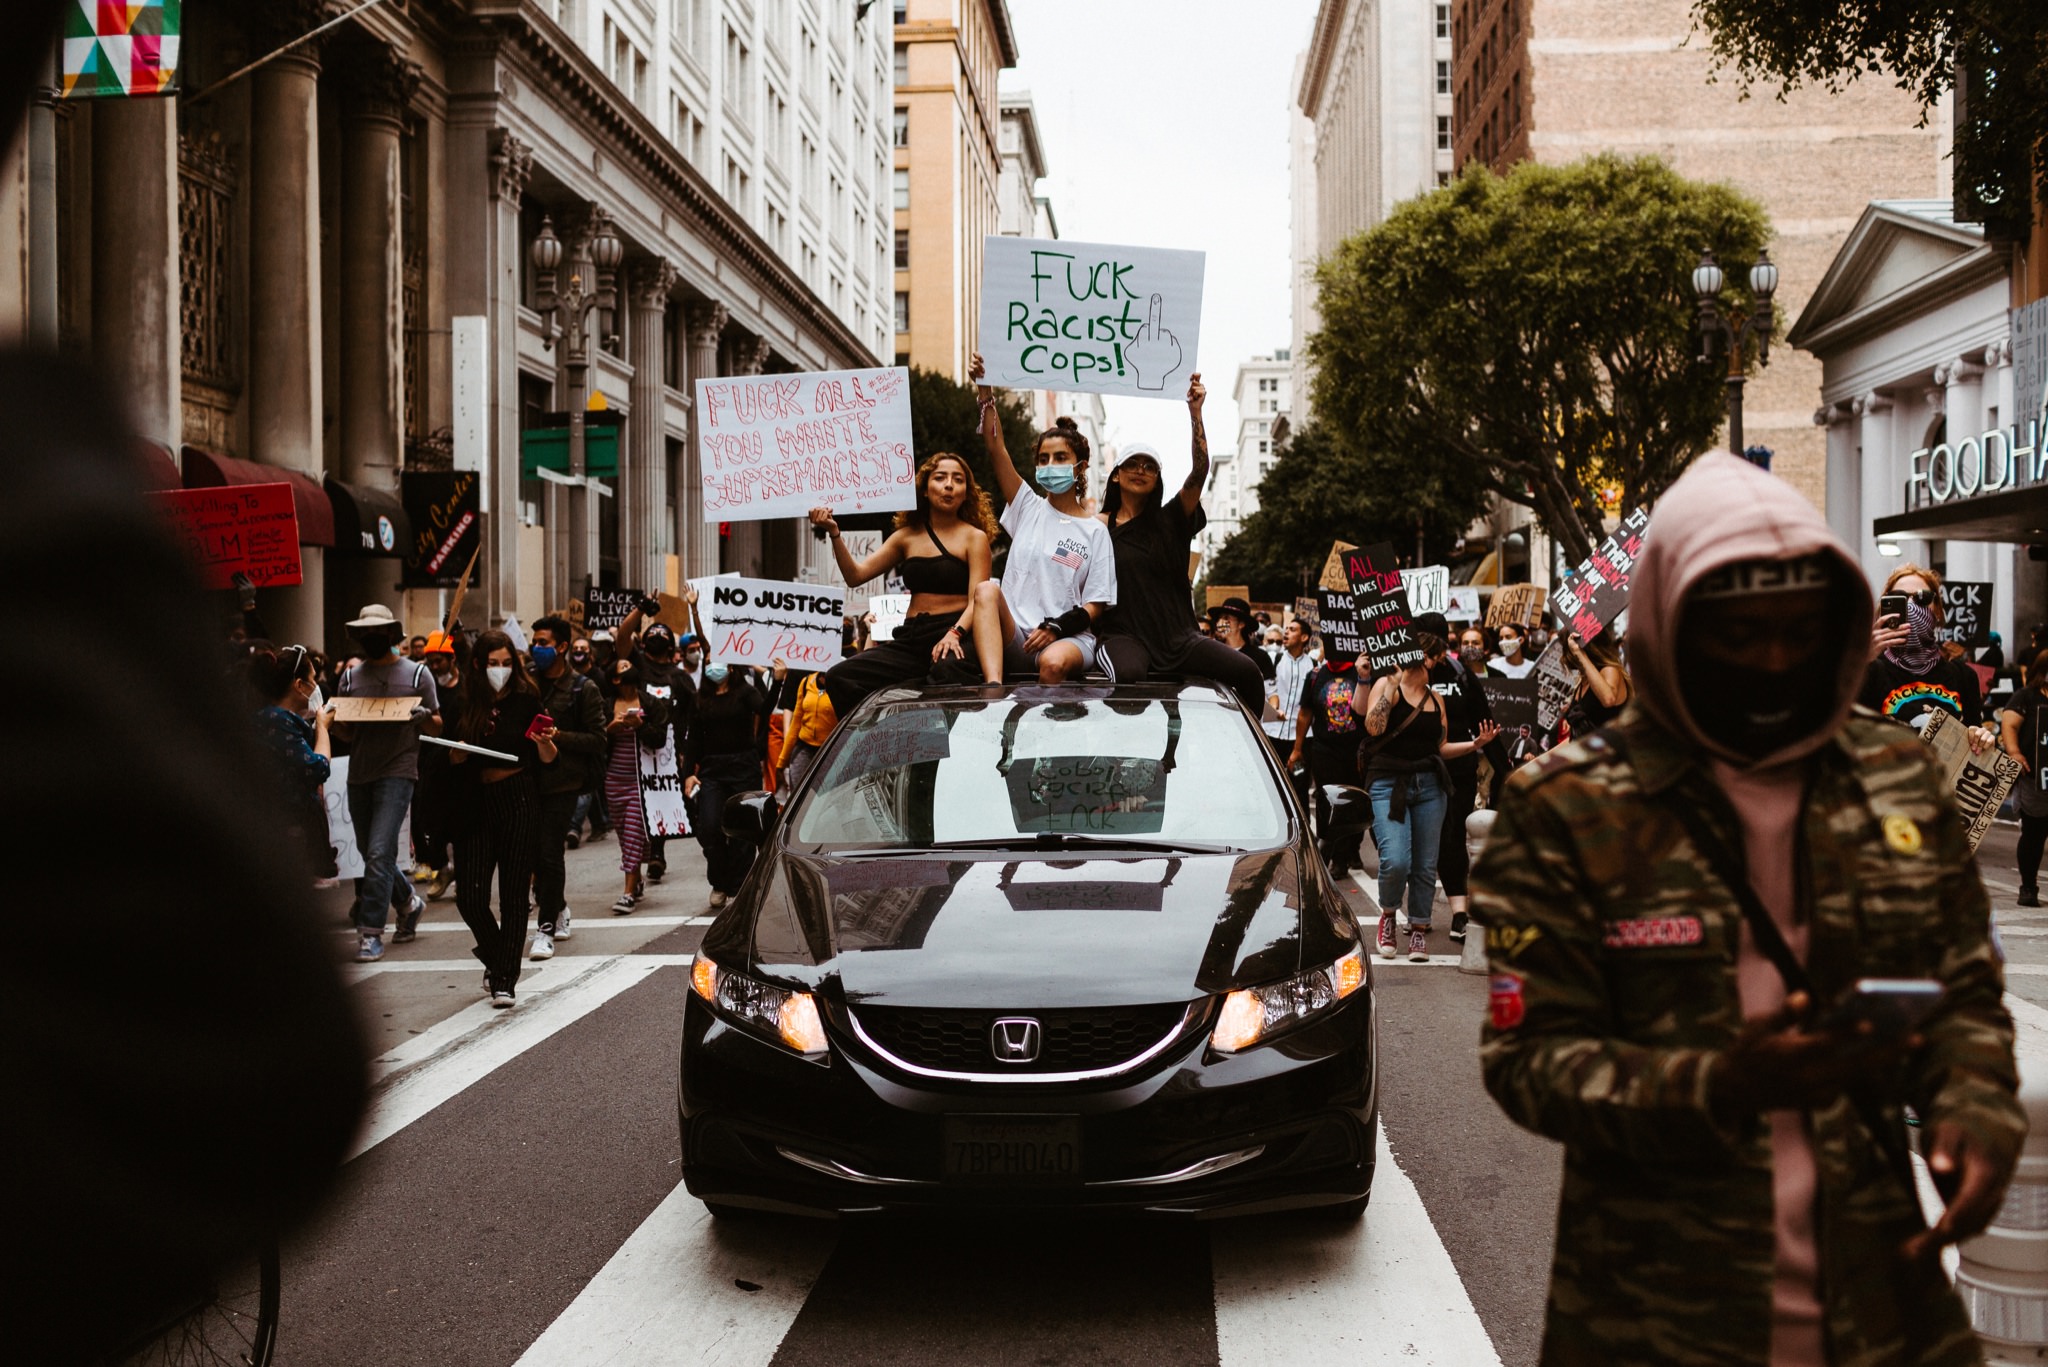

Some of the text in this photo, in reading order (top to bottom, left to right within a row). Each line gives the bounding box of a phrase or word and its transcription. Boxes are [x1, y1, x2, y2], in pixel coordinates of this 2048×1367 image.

[1031, 250, 1142, 302] FUCK
[1008, 300, 1142, 341] Racist
[1020, 342, 1125, 383] Cops!
[705, 376, 876, 427] FUCK ALL
[704, 410, 878, 470] YOU WHITE
[704, 441, 914, 511] SUPREMACISTS
[361, 531, 375, 549] 719
[430, 514, 474, 571] PARKING
[833, 535, 876, 558] LACK
[1057, 540, 1089, 560] DONALD
[1066, 538, 1087, 552] FUCK
[1602, 536, 1633, 574] THEN
[1350, 556, 1378, 579] ALL
[590, 589, 633, 604] BLACK
[714, 587, 748, 607] NO
[1353, 580, 1377, 596] LIVES
[1938, 584, 1982, 606] ACK
[599, 604, 637, 616] LIVES
[879, 598, 910, 616] JUS
[1327, 594, 1355, 609] RAC
[1360, 600, 1399, 620] MATTER
[1553, 583, 1583, 618] THEN
[589, 616, 625, 627] MATTE
[1375, 615, 1410, 634] UNTIL
[1942, 606, 1976, 623] VES
[1320, 620, 1358, 635] SMALL
[718, 629, 832, 663] No Peace
[1335, 637, 1367, 653] ENER
[1366, 628, 1412, 652] BLACK
[1371, 649, 1424, 670] LIVES MATTER
[642, 773, 679, 792] NEXT?
[1974, 819, 1988, 840] LIKE
[1982, 801, 1998, 820] THEY
[1992, 785, 2007, 801] GOT
[952, 1142, 1073, 1173] 7BPH040
